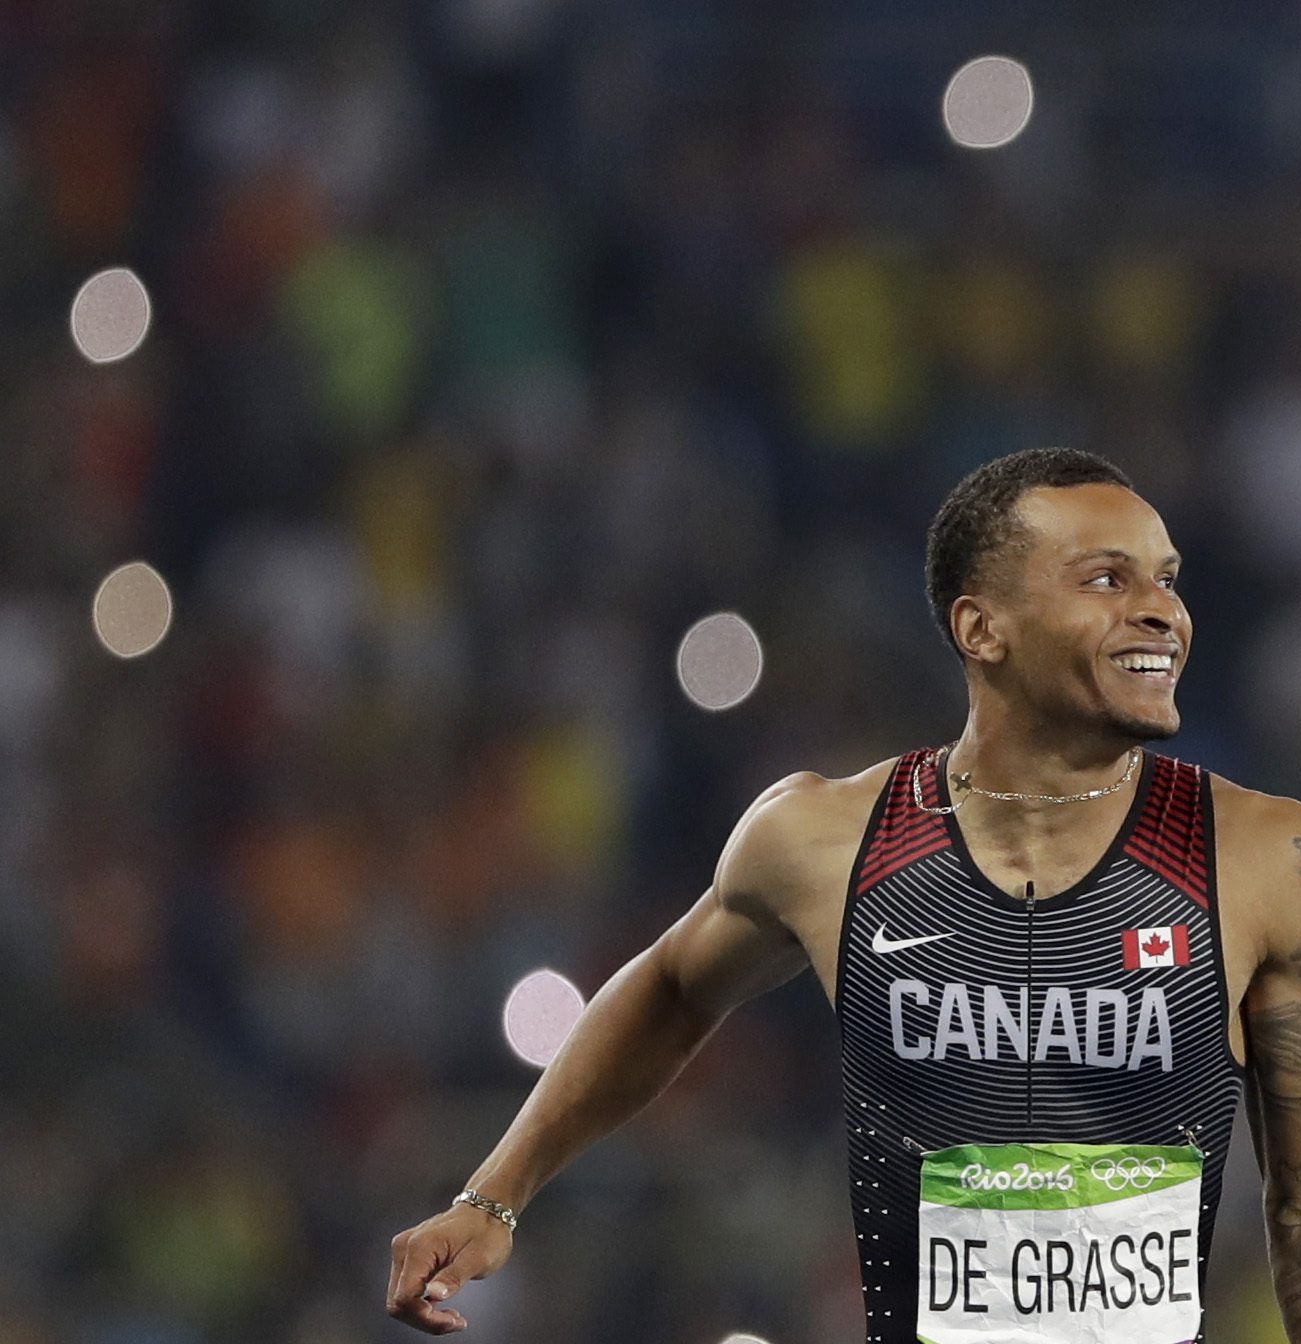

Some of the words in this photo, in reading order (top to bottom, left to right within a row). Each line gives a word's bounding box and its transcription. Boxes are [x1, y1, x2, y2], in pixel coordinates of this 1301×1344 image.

[888, 978, 1174, 1073] CANADA
[960, 1162, 1075, 1192] Rio2016
[928, 1236, 989, 1313] DE
[1011, 1229, 1193, 1316] GRASSE
